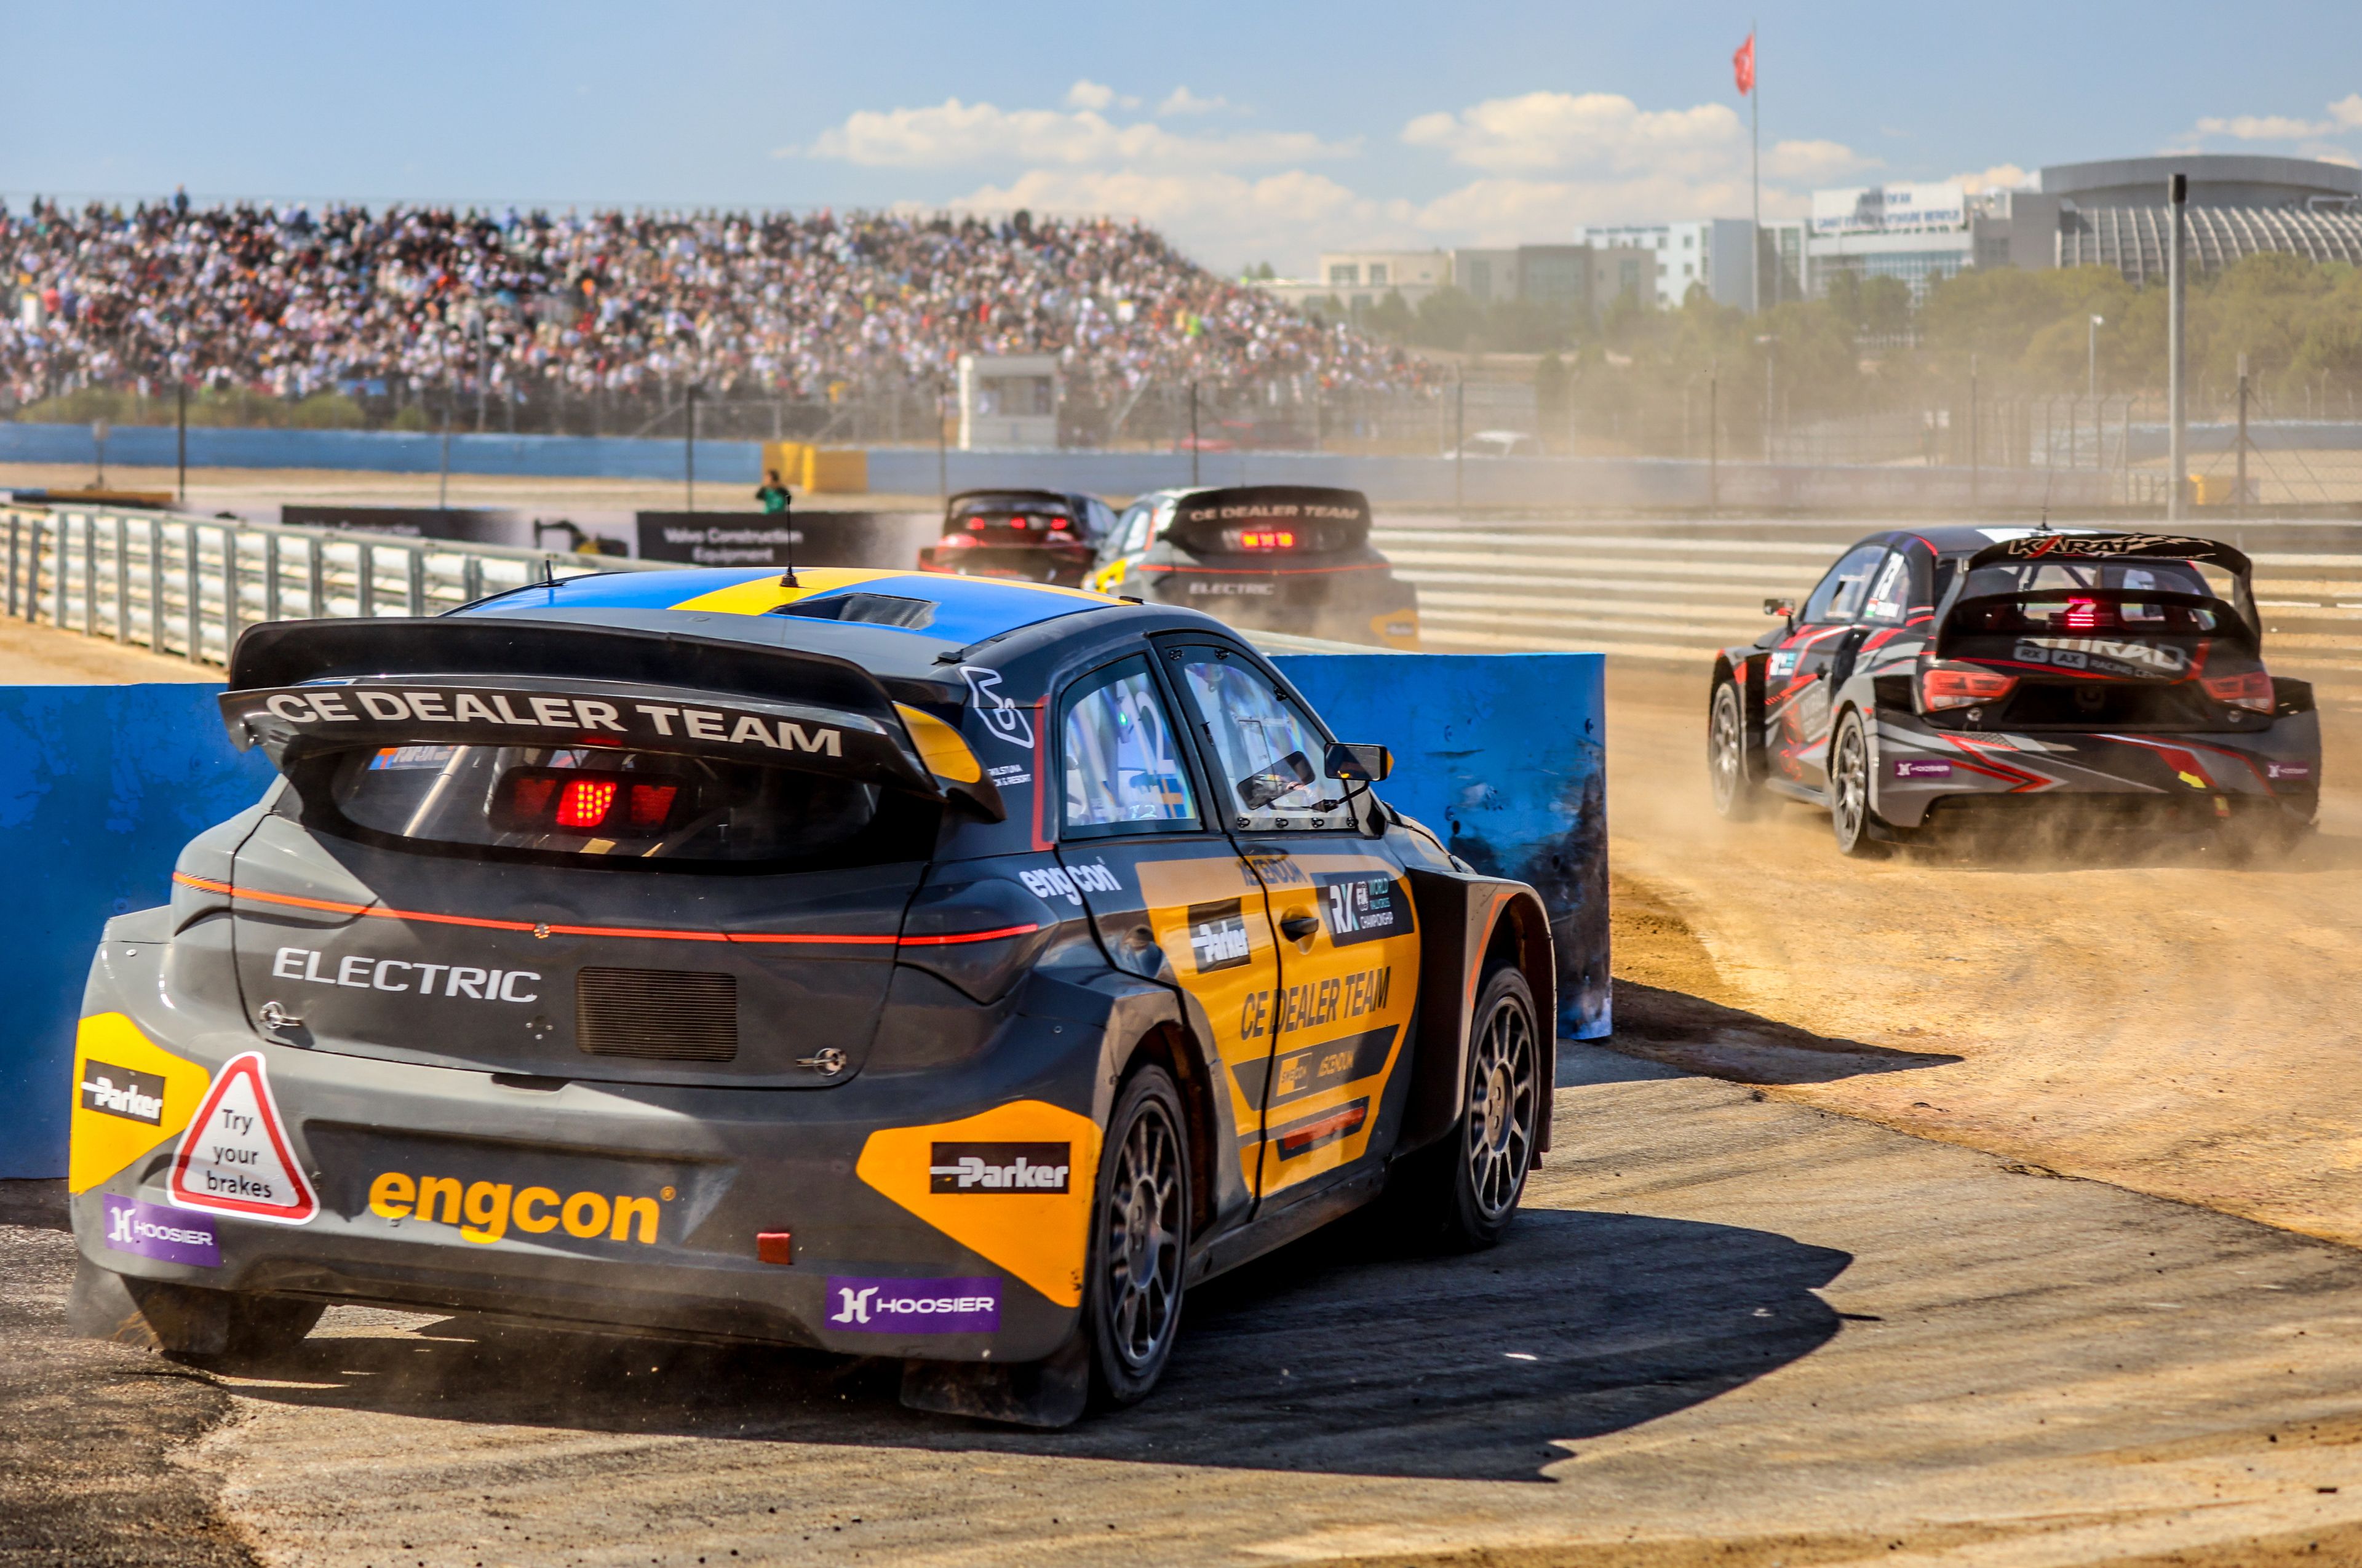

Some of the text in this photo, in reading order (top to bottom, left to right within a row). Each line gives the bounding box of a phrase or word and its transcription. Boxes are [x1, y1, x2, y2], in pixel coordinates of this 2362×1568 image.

[1190, 505, 1359, 522] CE DEALER TEAM
[1190, 583, 1276, 595] ELECTRIC
[2020, 649, 2080, 664] RX AX
[264, 691, 843, 758] CE DEALER TEAM
[1019, 864, 1123, 905] engcon
[1329, 882, 1360, 934] RX
[1198, 920, 1249, 963] Parker
[272, 946, 542, 1003] ELECTRIC
[1241, 966, 1391, 1041] CE DEALER TEAM
[92, 1076, 163, 1120] Parker
[222, 1109, 253, 1136] Try
[213, 1146, 259, 1165] your
[206, 1170, 272, 1198] brakes
[957, 1156, 1069, 1188] Parker
[369, 1171, 661, 1244] engcon
[133, 1220, 214, 1246] HOOSIER
[875, 1296, 995, 1315] HOOSIER
